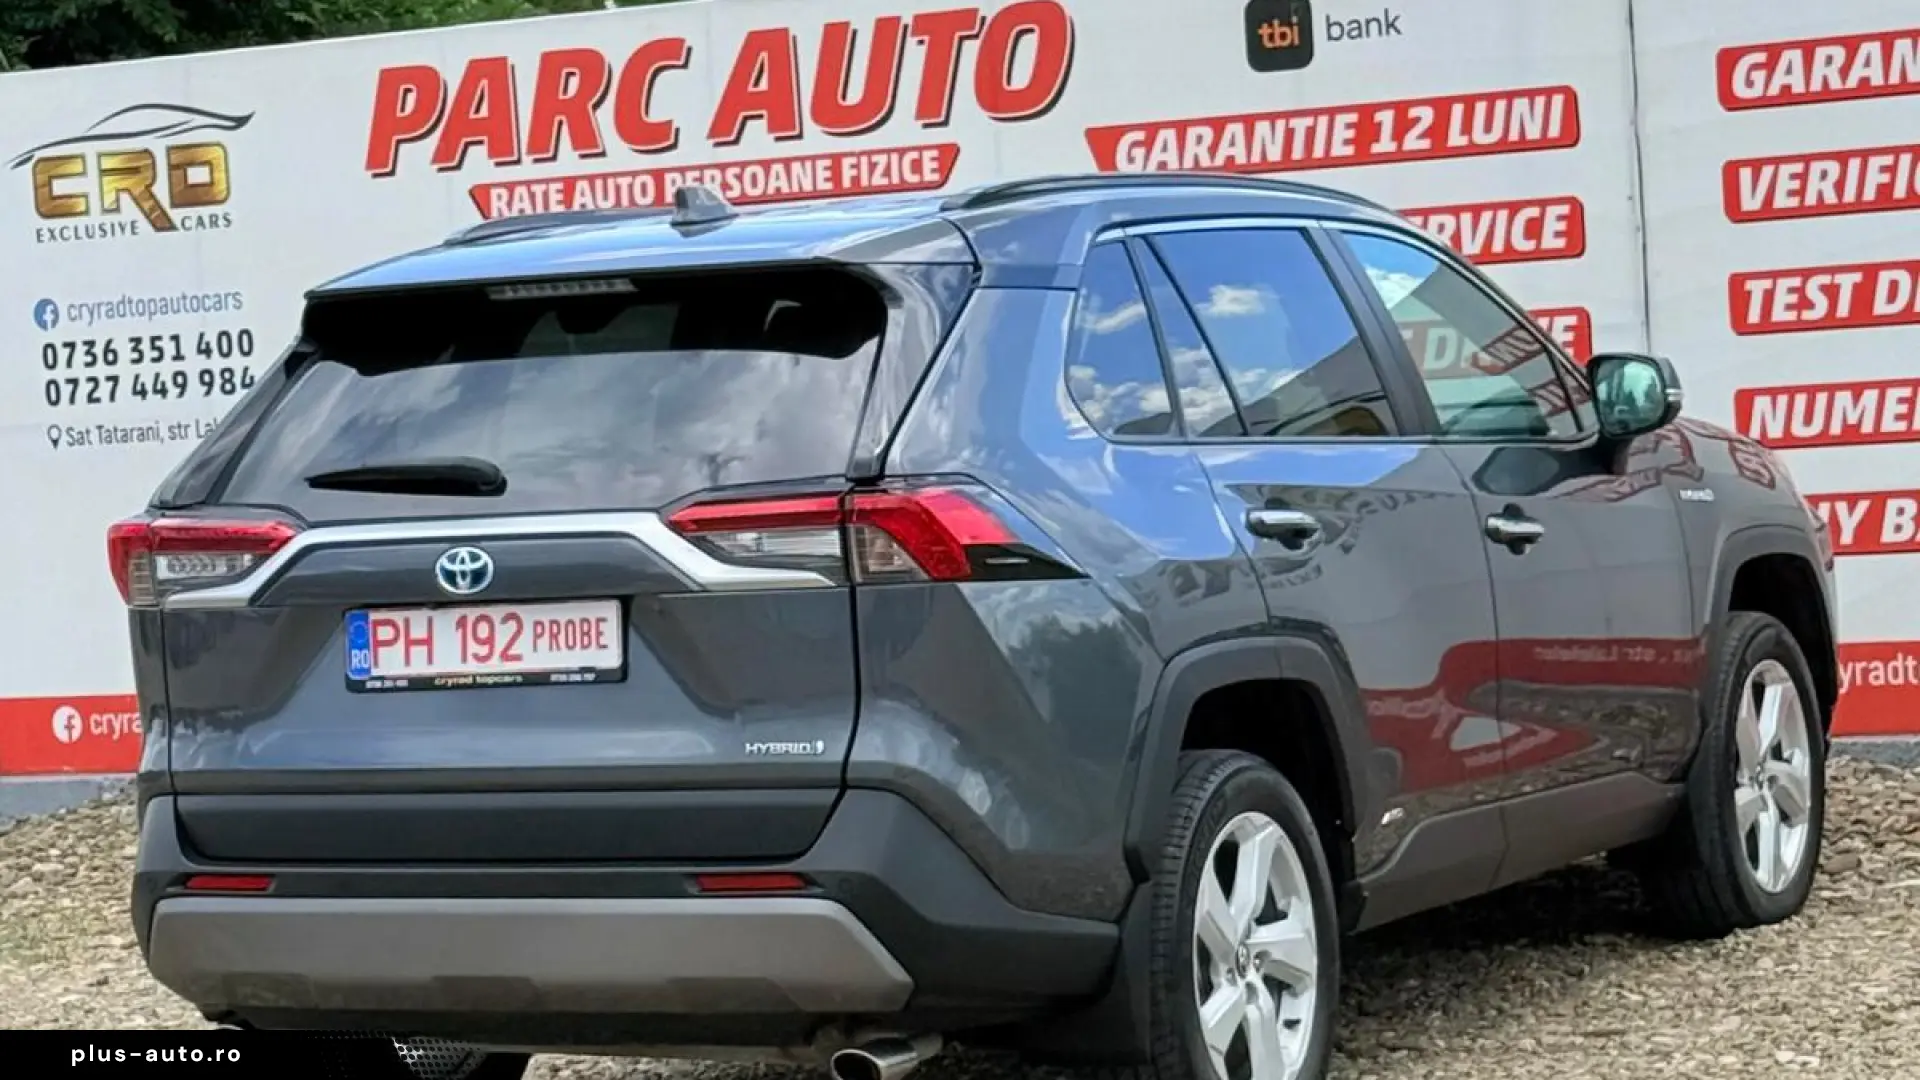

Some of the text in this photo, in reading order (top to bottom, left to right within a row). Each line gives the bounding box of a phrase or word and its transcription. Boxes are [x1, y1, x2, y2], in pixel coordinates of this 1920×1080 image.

[1257, 8, 1402, 48] tbi bank
[364, 0, 1075, 177] PARC AUTO
[1732, 37, 1920, 99] GARAN
[1115, 94, 1565, 171] GARANTIE 12 LUNI
[32, 141, 231, 232] CRD
[489, 182, 565, 218] RATE
[572, 173, 656, 209] AUTO
[841, 148, 940, 189] FIZICE
[1739, 153, 1920, 212] VERIFI
[35, 212, 233, 243] EXCLUSIVE CARS
[1407, 204, 1571, 256] RVICE
[67, 289, 243, 327] cryradtopautocars
[1745, 268, 1920, 324] TEST D
[42, 328, 254, 370] 0736 351 400
[45, 366, 255, 406] 0727 449 984
[66, 424, 92, 447] Sat
[98, 419, 164, 446] Tatarani,
[168, 420, 191, 441] str
[1750, 386, 1920, 440] NUME
[1880, 498, 1920, 543] B
[351, 649, 370, 670] RO
[371, 612, 608, 668] PH 192 PROBE
[1839, 651, 1920, 694] yradt
[745, 742, 812, 755] HYBRID
